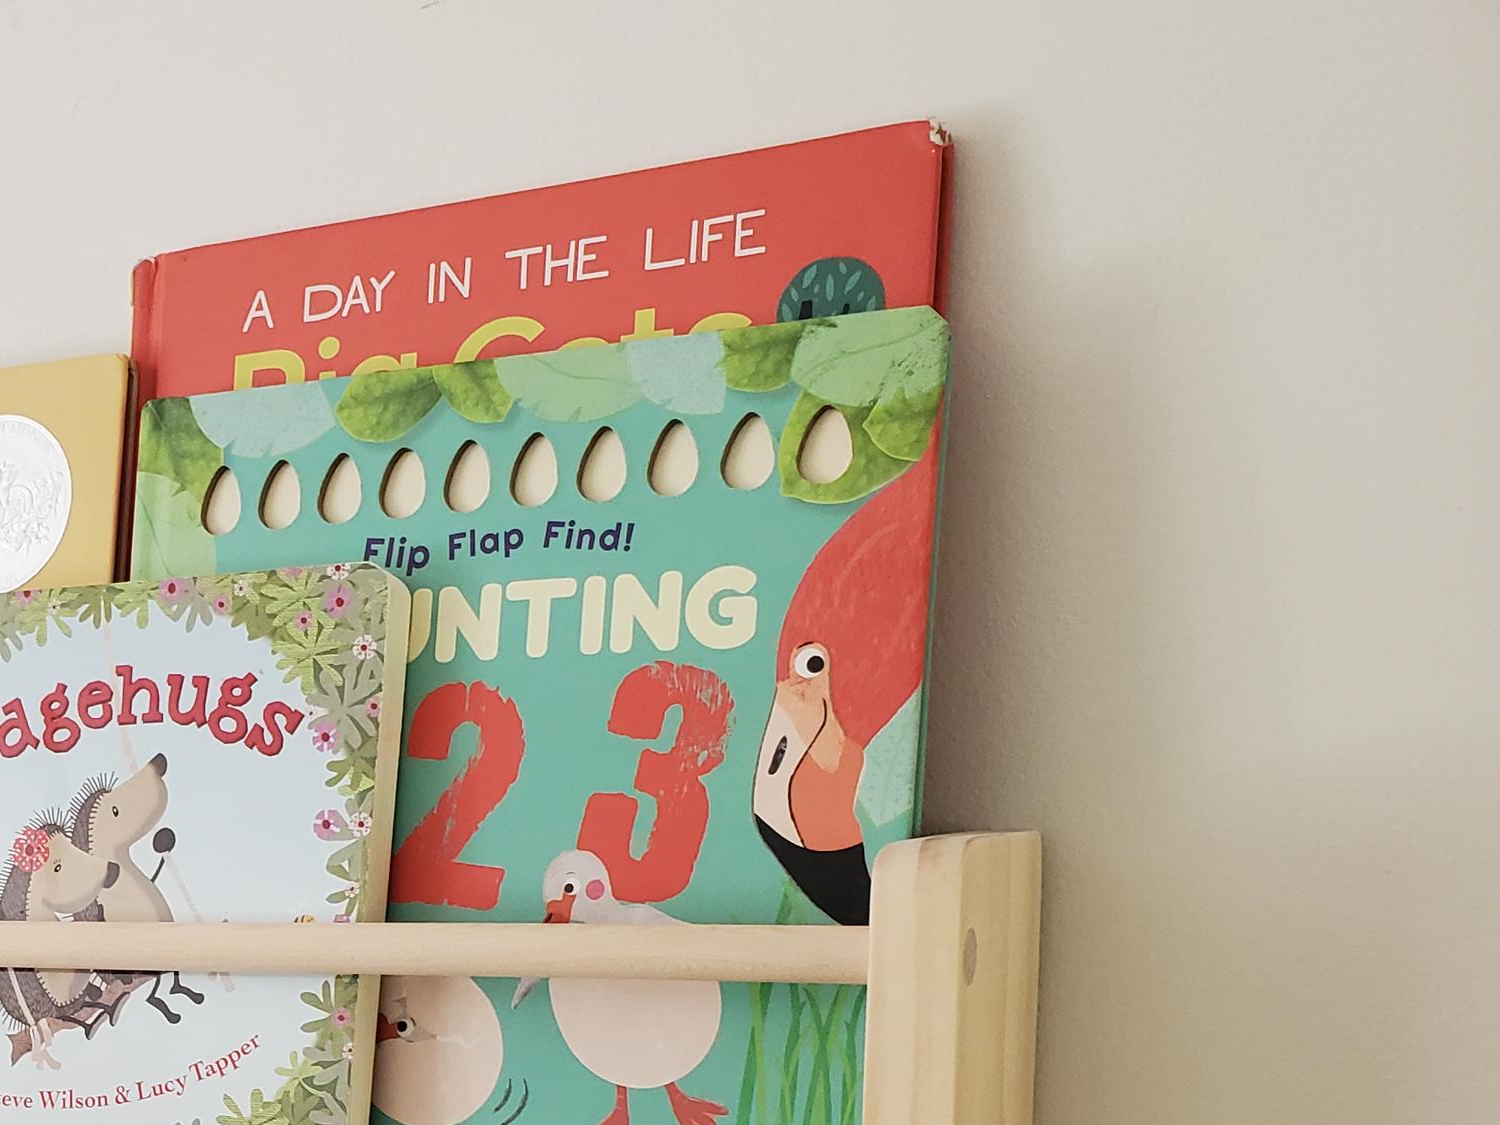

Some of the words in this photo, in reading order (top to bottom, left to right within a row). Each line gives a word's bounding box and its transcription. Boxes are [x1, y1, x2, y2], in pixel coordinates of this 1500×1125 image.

[242, 290, 274, 333] A
[303, 270, 396, 323] DAY
[427, 257, 472, 304] IN
[504, 235, 610, 291] THE
[644, 208, 767, 271] LIFE
[364, 538, 430, 576] Flip
[448, 528, 524, 558] Flap
[542, 520, 636, 552] Find!
[388, 679, 527, 911] 2
[576, 660, 736, 905] 3
[39, 1089, 109, 1110] Wilson
[114, 1085, 131, 1105] &
[135, 1075, 188, 1101] Lucy
[189, 1034, 261, 1083] Tapper
